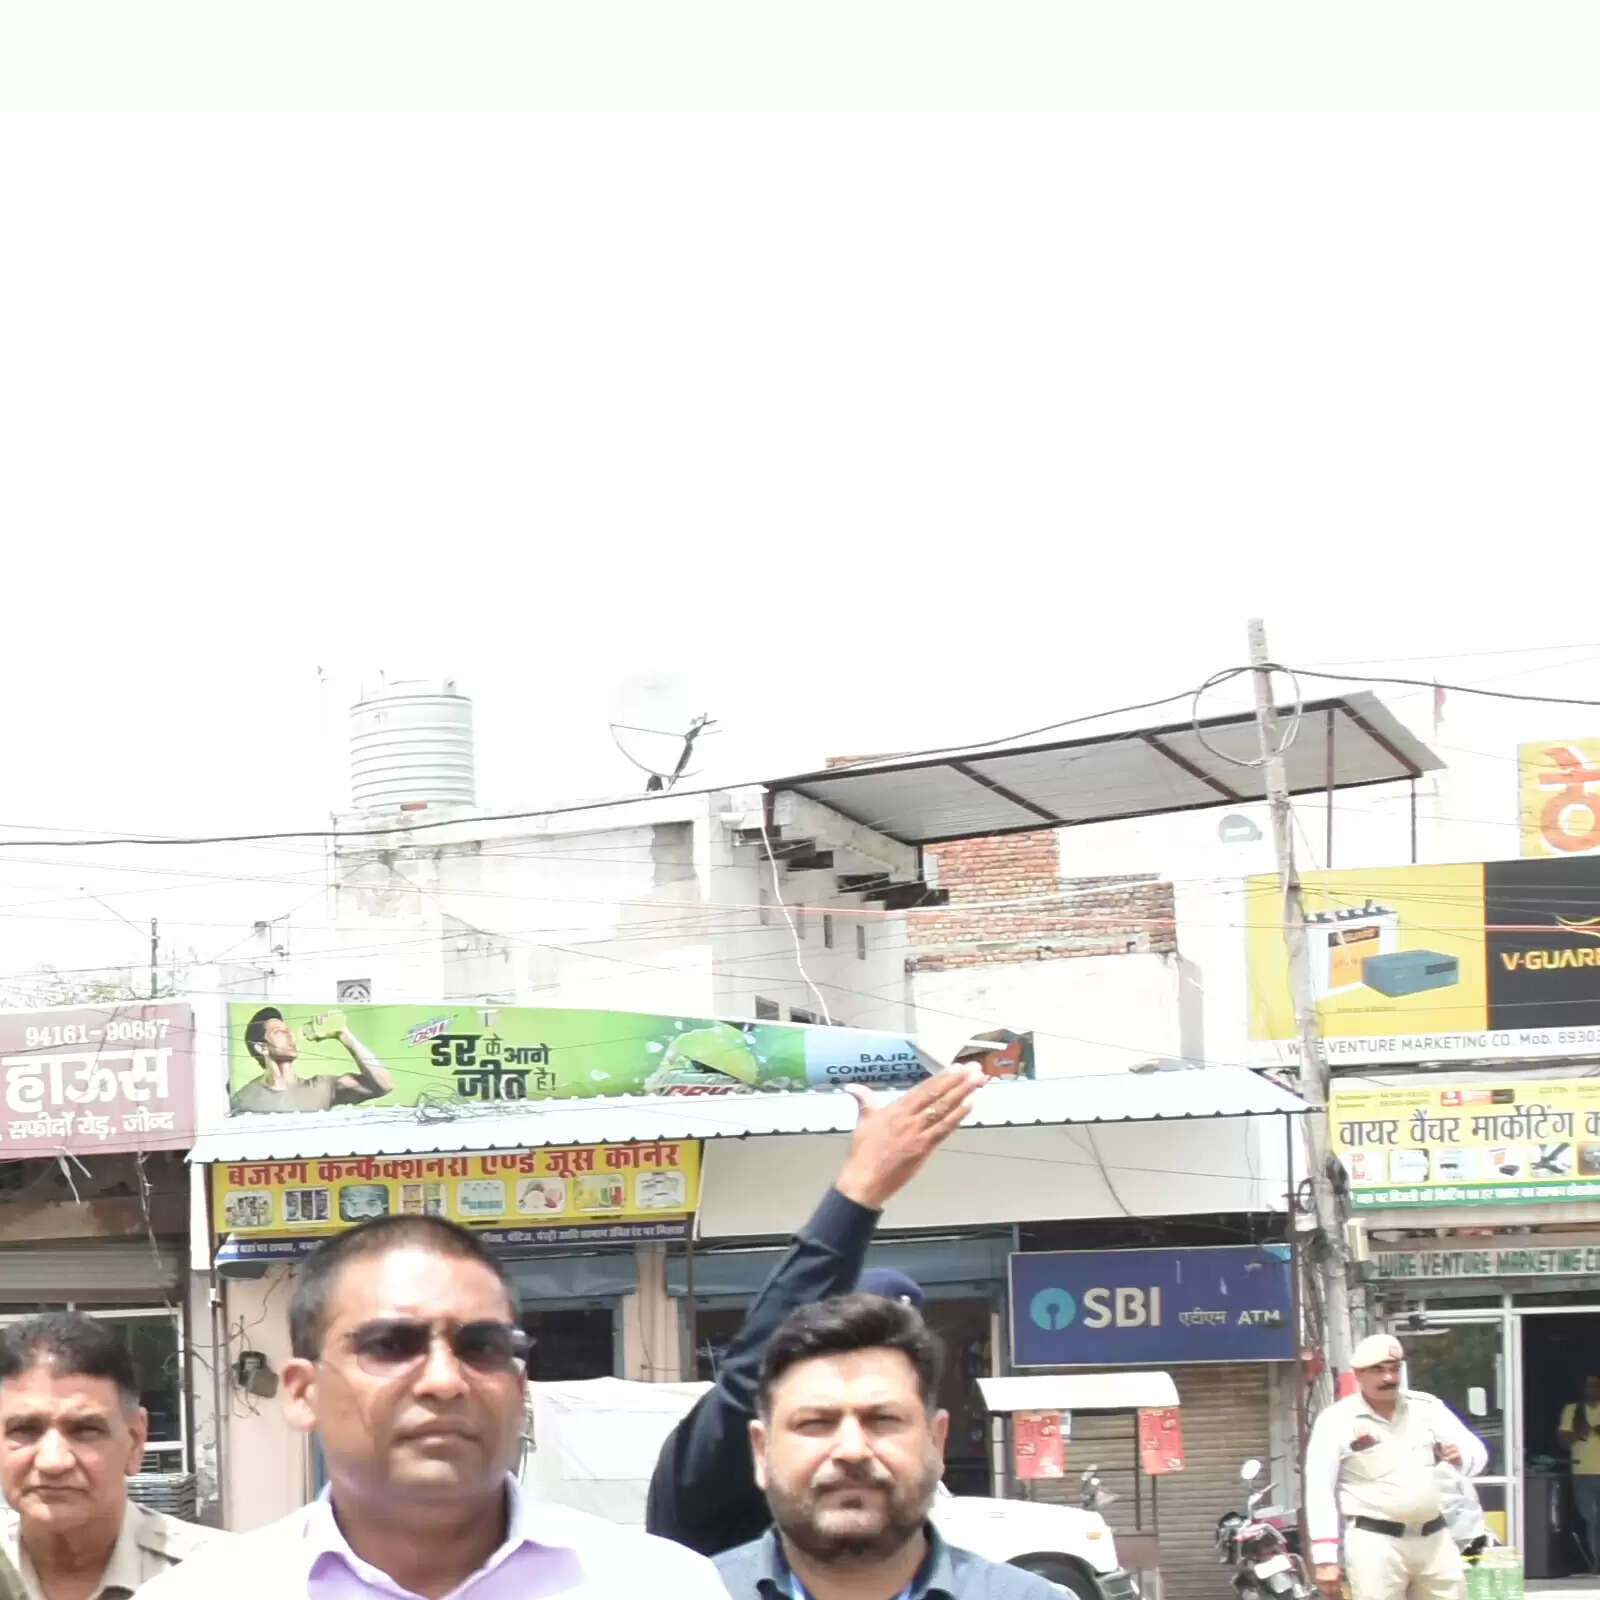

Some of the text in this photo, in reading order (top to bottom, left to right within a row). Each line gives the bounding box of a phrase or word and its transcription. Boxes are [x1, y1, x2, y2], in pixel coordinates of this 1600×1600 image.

[429, 1032, 553, 1067] डर के आगे
[1329, 1038, 1396, 1055] VENTURE
[1402, 1034, 1487, 1052] MARKETING
[2, 1047, 173, 1113] हाऊस
[451, 1058, 533, 1100] जीत
[1338, 1119, 1401, 1147] वायर
[1470, 1103, 1576, 1142] मार्केटिंग
[544, 1148, 595, 1179] जूस
[1083, 1286, 1281, 1329] SBI एटीएम ATM
